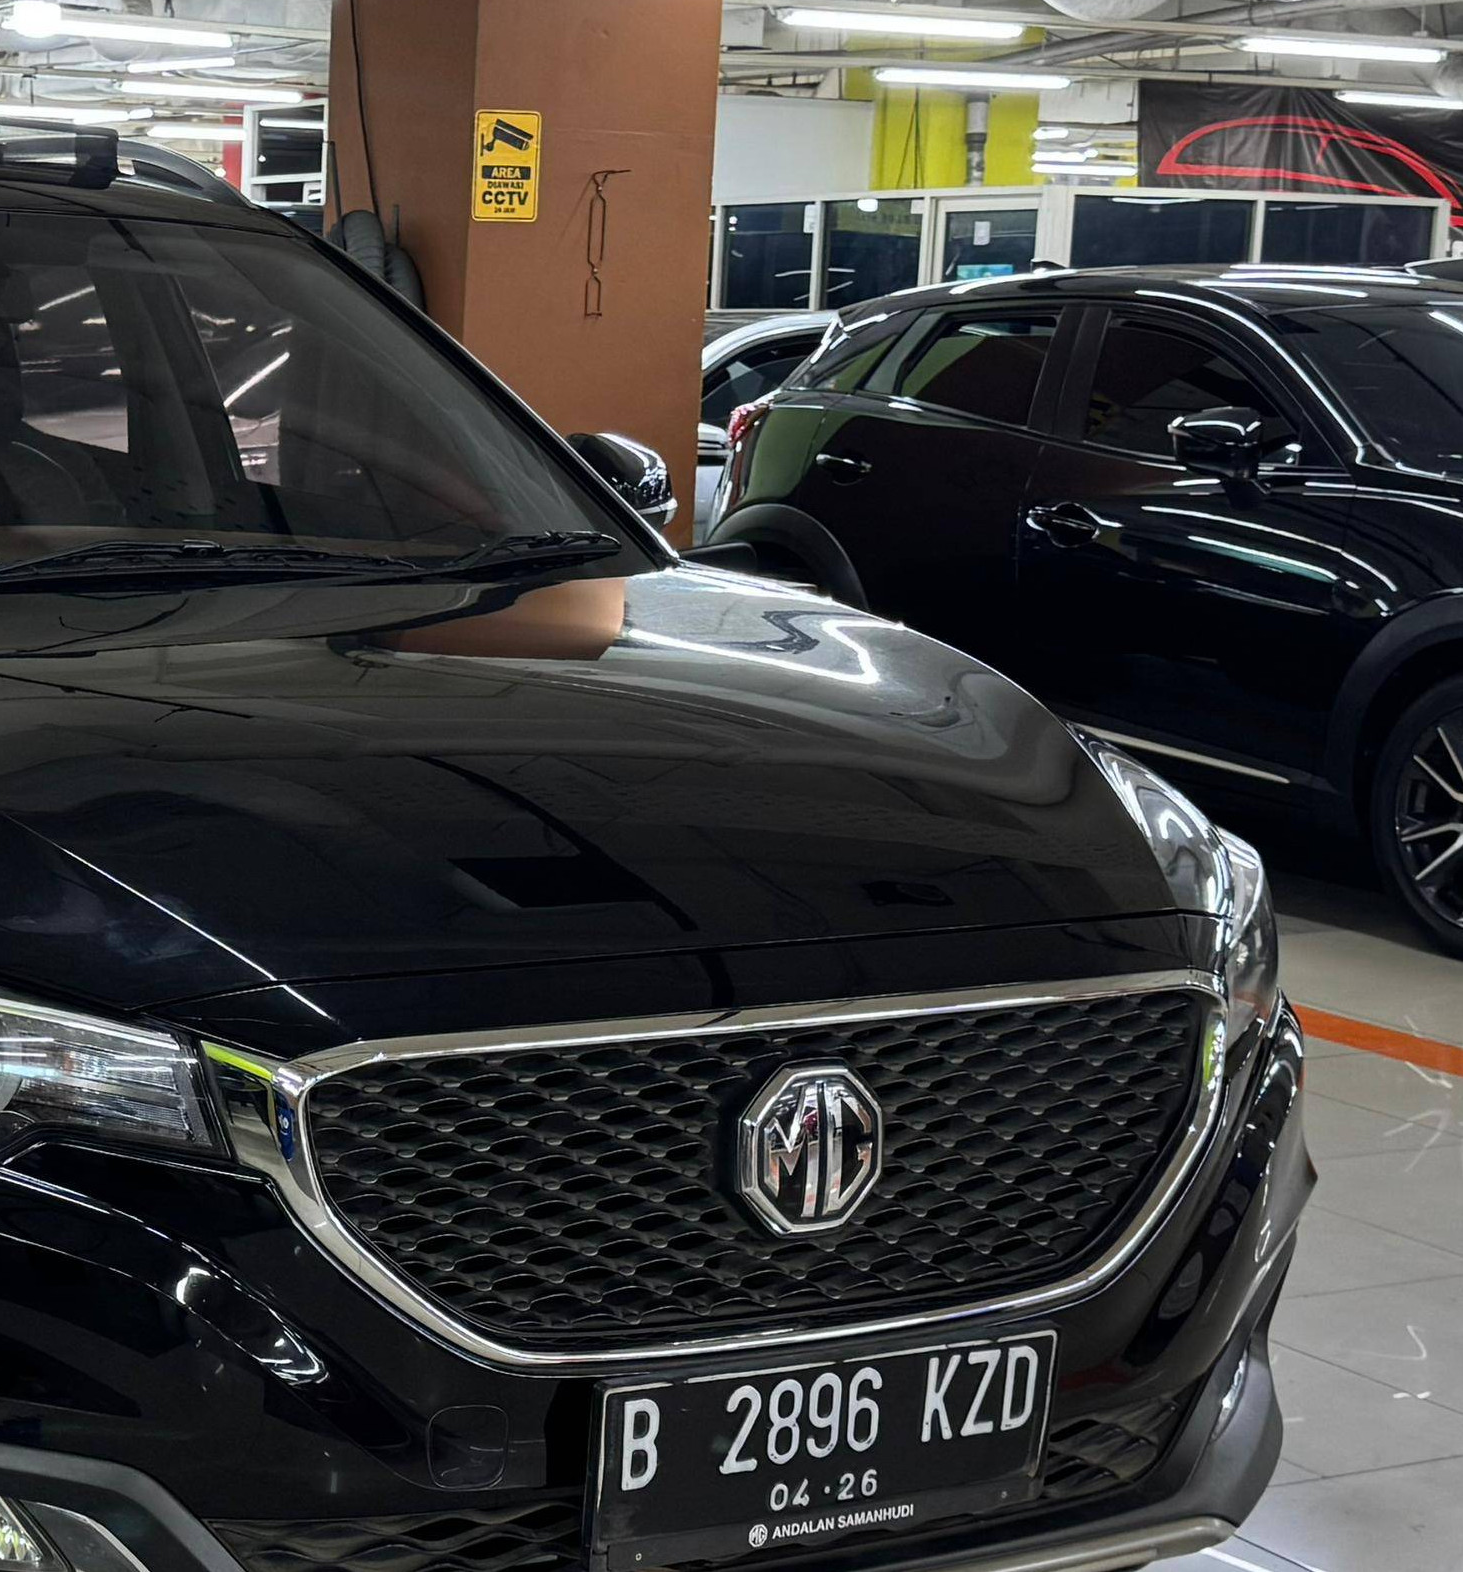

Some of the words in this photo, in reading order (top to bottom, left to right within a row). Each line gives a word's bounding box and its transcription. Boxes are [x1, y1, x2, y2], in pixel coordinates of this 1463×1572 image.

[491, 167, 521, 178] AREA
[482, 190, 528, 205] CCTV
[760, 1076, 875, 1220] MG
[621, 1398, 660, 1491] B
[718, 1366, 883, 1475] 2896
[921, 1345, 1038, 1443] KZD
[772, 1517, 835, 1539] ANDALAN
[838, 1504, 914, 1528] SAMANHUDI
